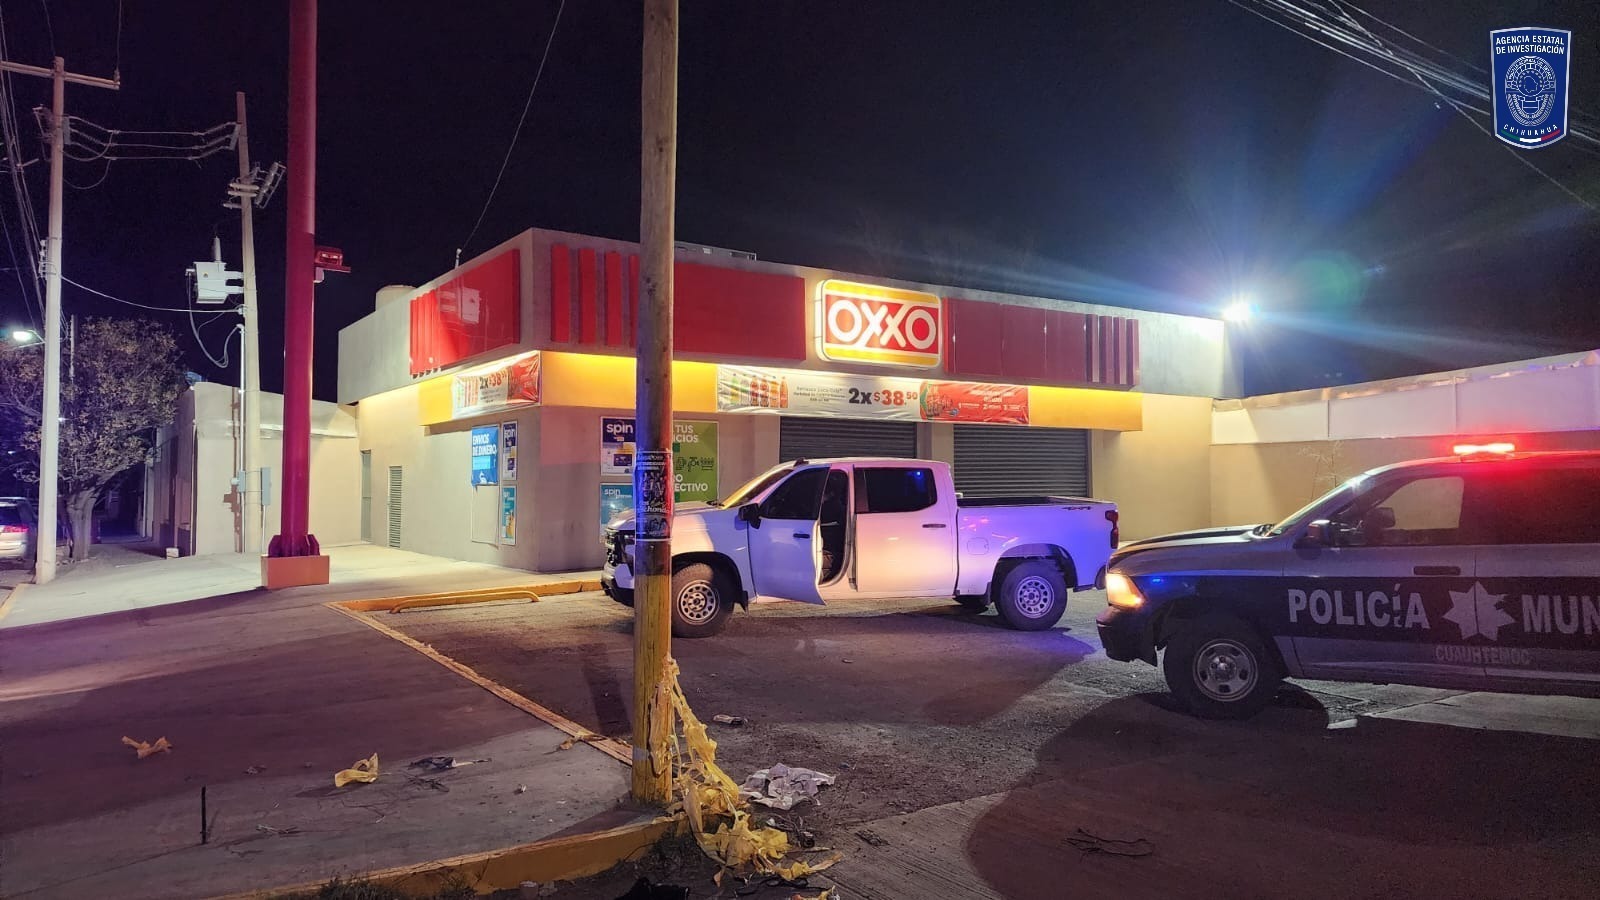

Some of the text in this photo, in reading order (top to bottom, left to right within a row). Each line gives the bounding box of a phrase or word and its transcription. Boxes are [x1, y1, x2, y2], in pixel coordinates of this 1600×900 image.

[828, 299, 936, 350] OXXO
[606, 423, 634, 436] spin
[675, 424, 694, 434] TUS
[673, 434, 699, 443] ICIOS
[674, 483, 709, 492] ECTIVO
[1522, 594, 1600, 635] MUN
